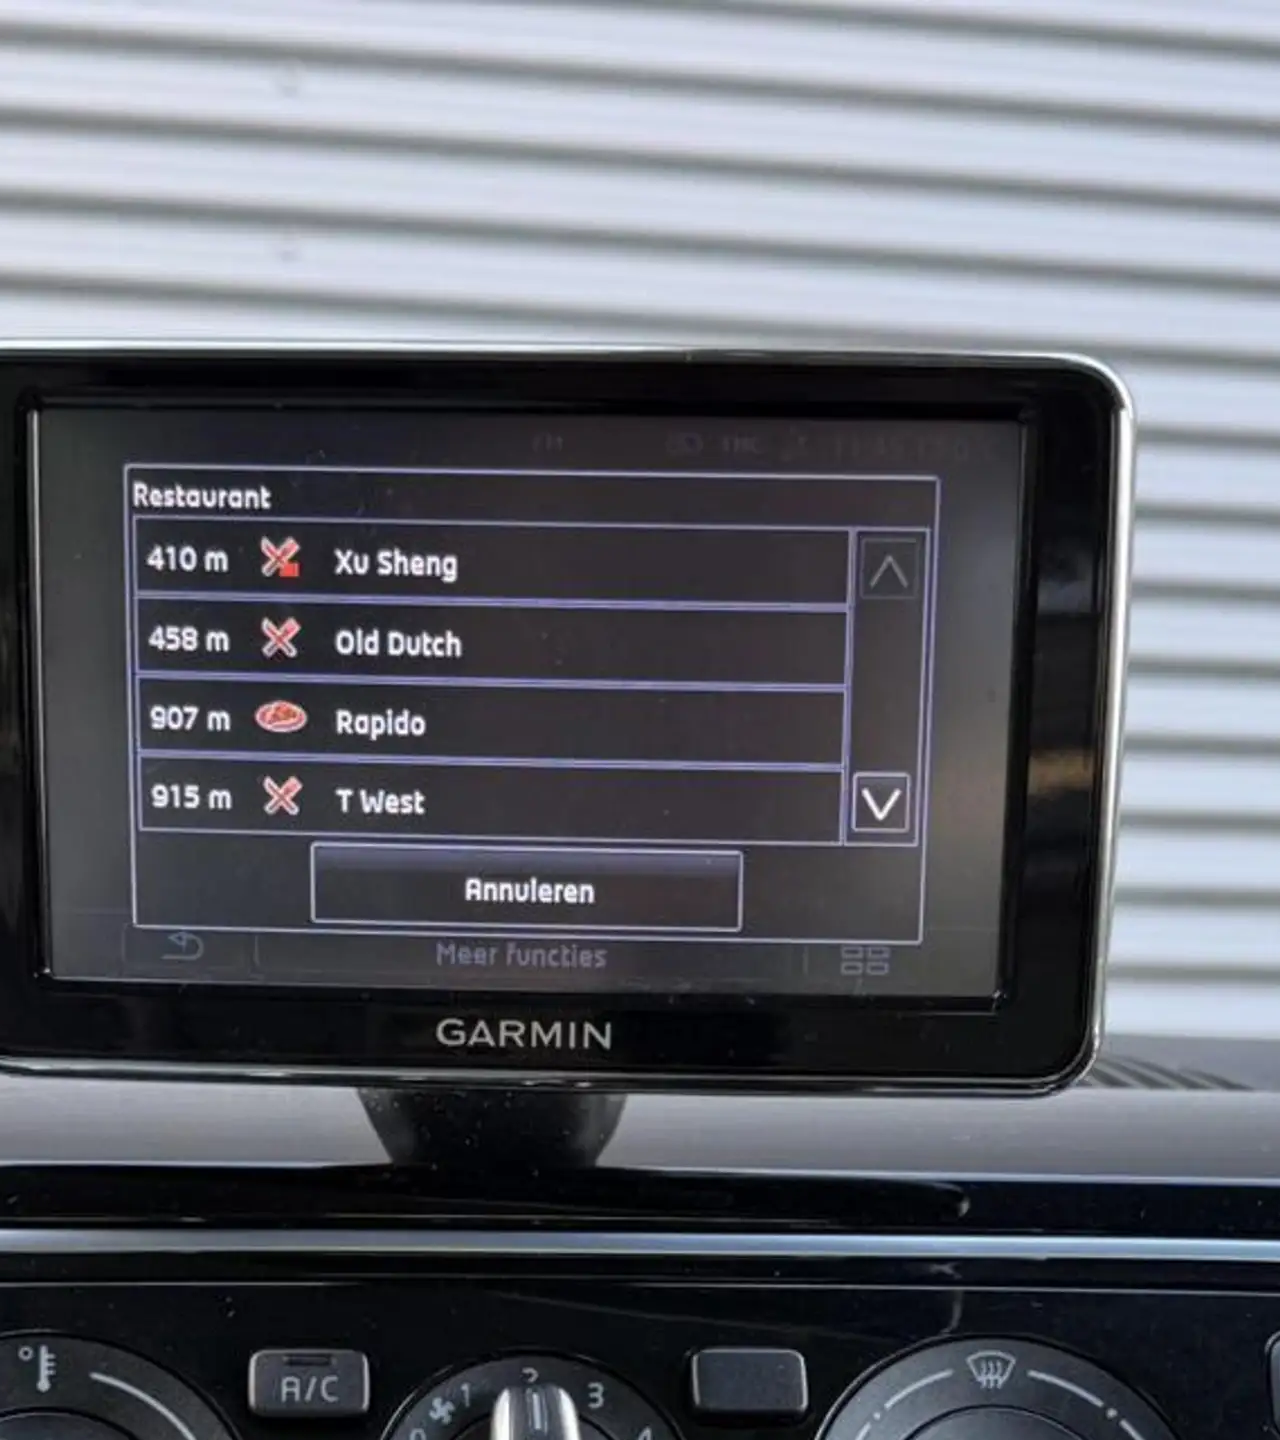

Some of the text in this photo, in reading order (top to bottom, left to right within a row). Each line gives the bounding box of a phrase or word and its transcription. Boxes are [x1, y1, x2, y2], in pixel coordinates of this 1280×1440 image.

[132, 481, 271, 510] Restaurant
[146, 545, 229, 572] 410 m
[334, 549, 458, 582] Xu Sheng
[148, 626, 230, 652] 458 m
[335, 628, 463, 658] Old Dutch
[149, 706, 231, 731] 907 m
[335, 710, 426, 740] Rapido
[151, 784, 233, 810] 915 m
[336, 788, 426, 815] T West
[465, 877, 596, 904] Annuleren
[436, 942, 609, 968] Meer functies
[435, 1017, 613, 1050] GARMIN
[281, 1375, 339, 1403] A/C
[460, 1383, 471, 1408] 1
[587, 1382, 605, 1409] 3
